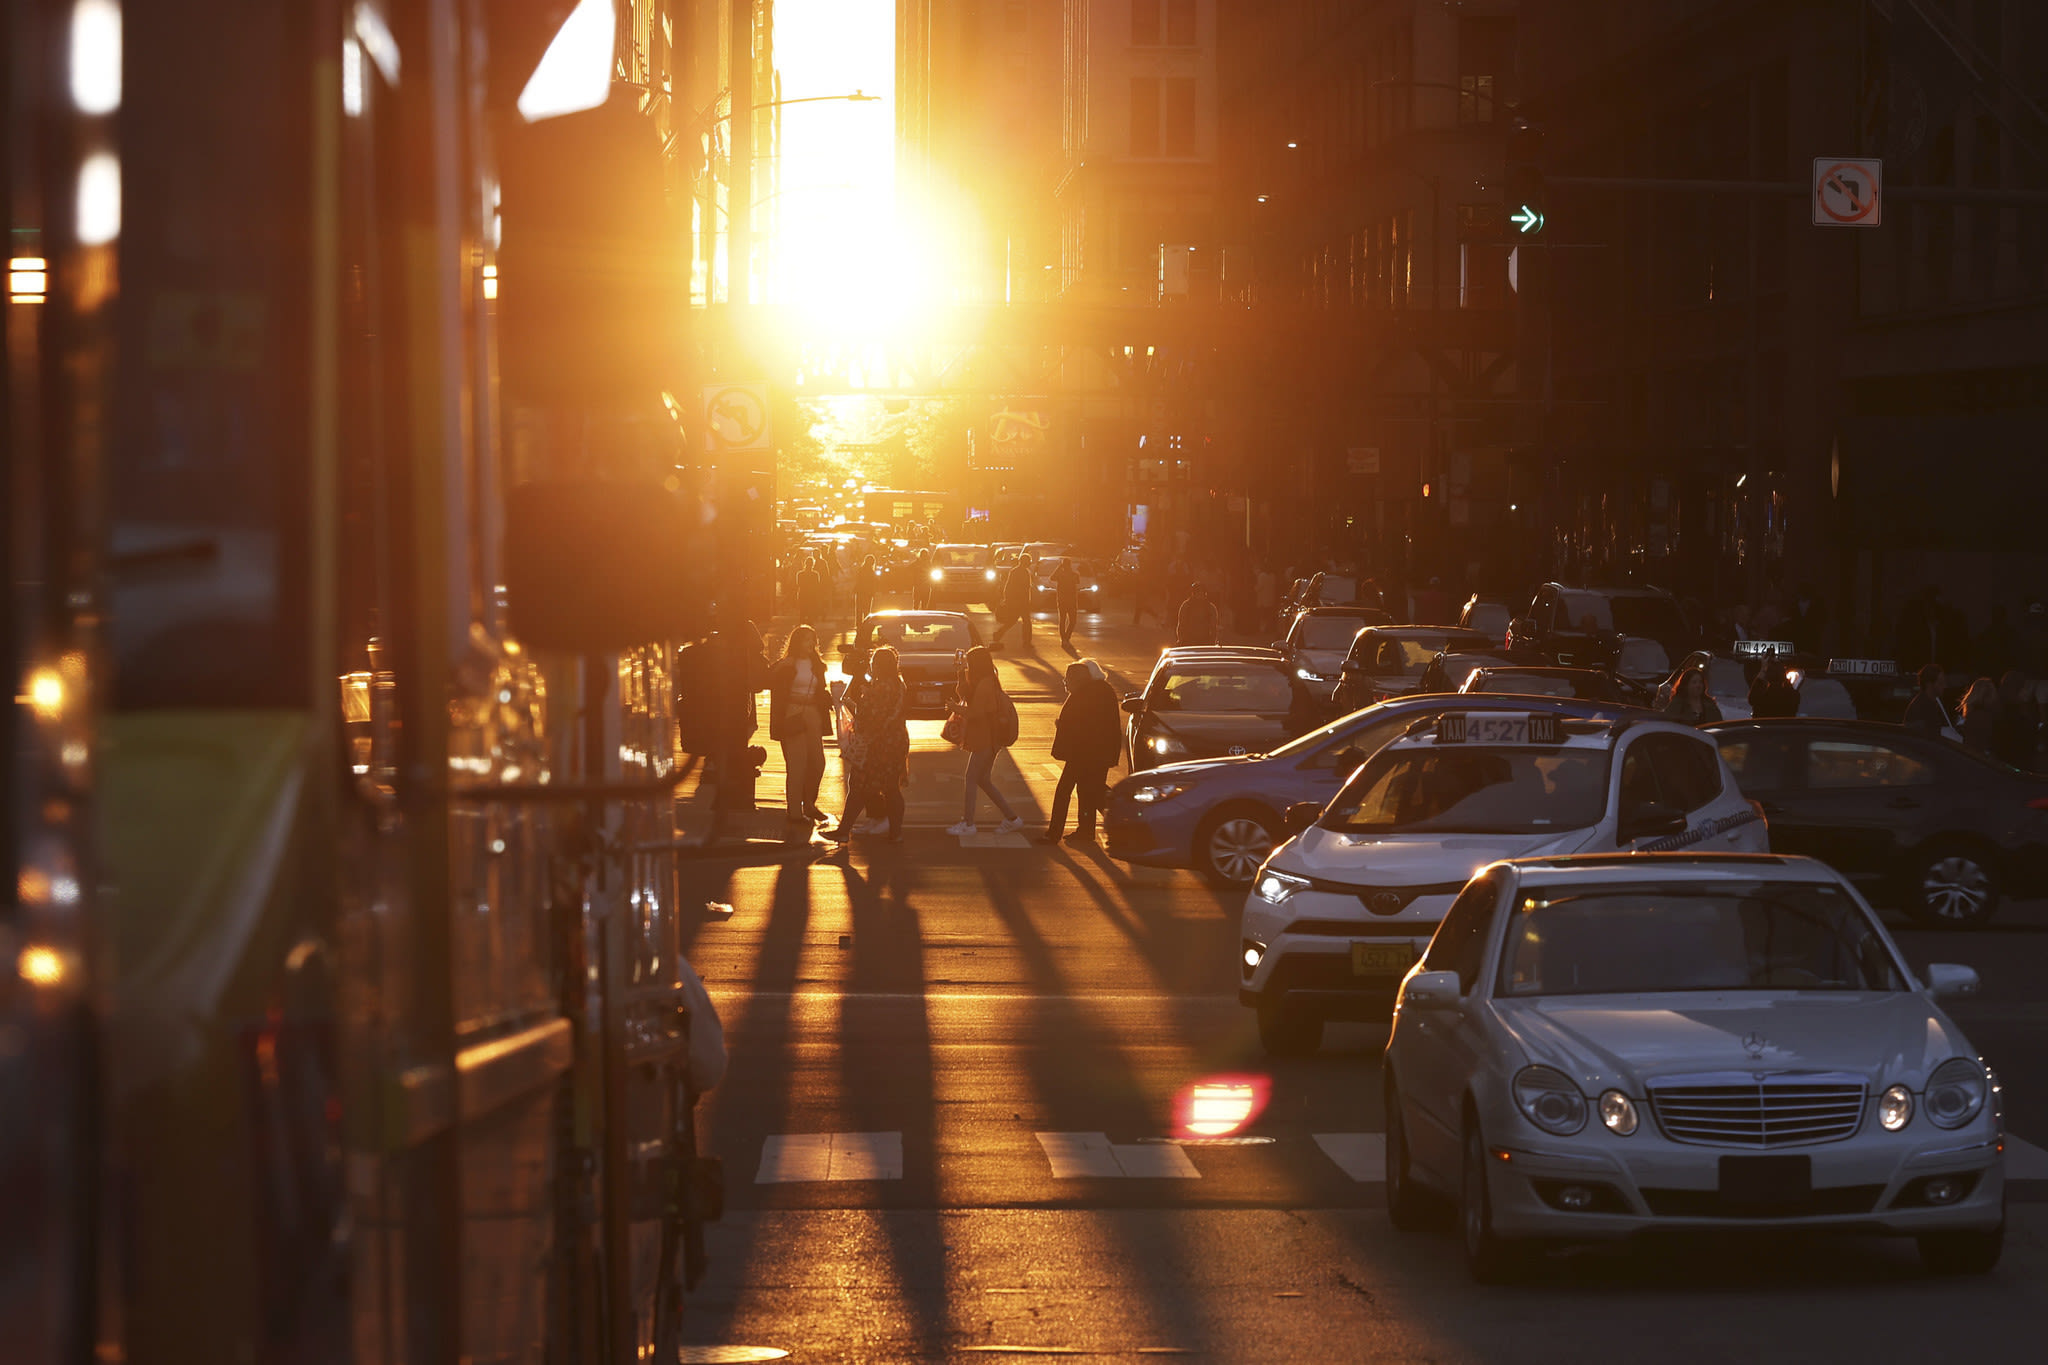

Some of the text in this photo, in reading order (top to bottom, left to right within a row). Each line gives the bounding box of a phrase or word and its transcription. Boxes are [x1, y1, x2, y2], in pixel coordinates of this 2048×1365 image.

[1737, 643, 1751, 653] TAXI
[1440, 719, 1554, 742] TAXI 4527 TAXI
